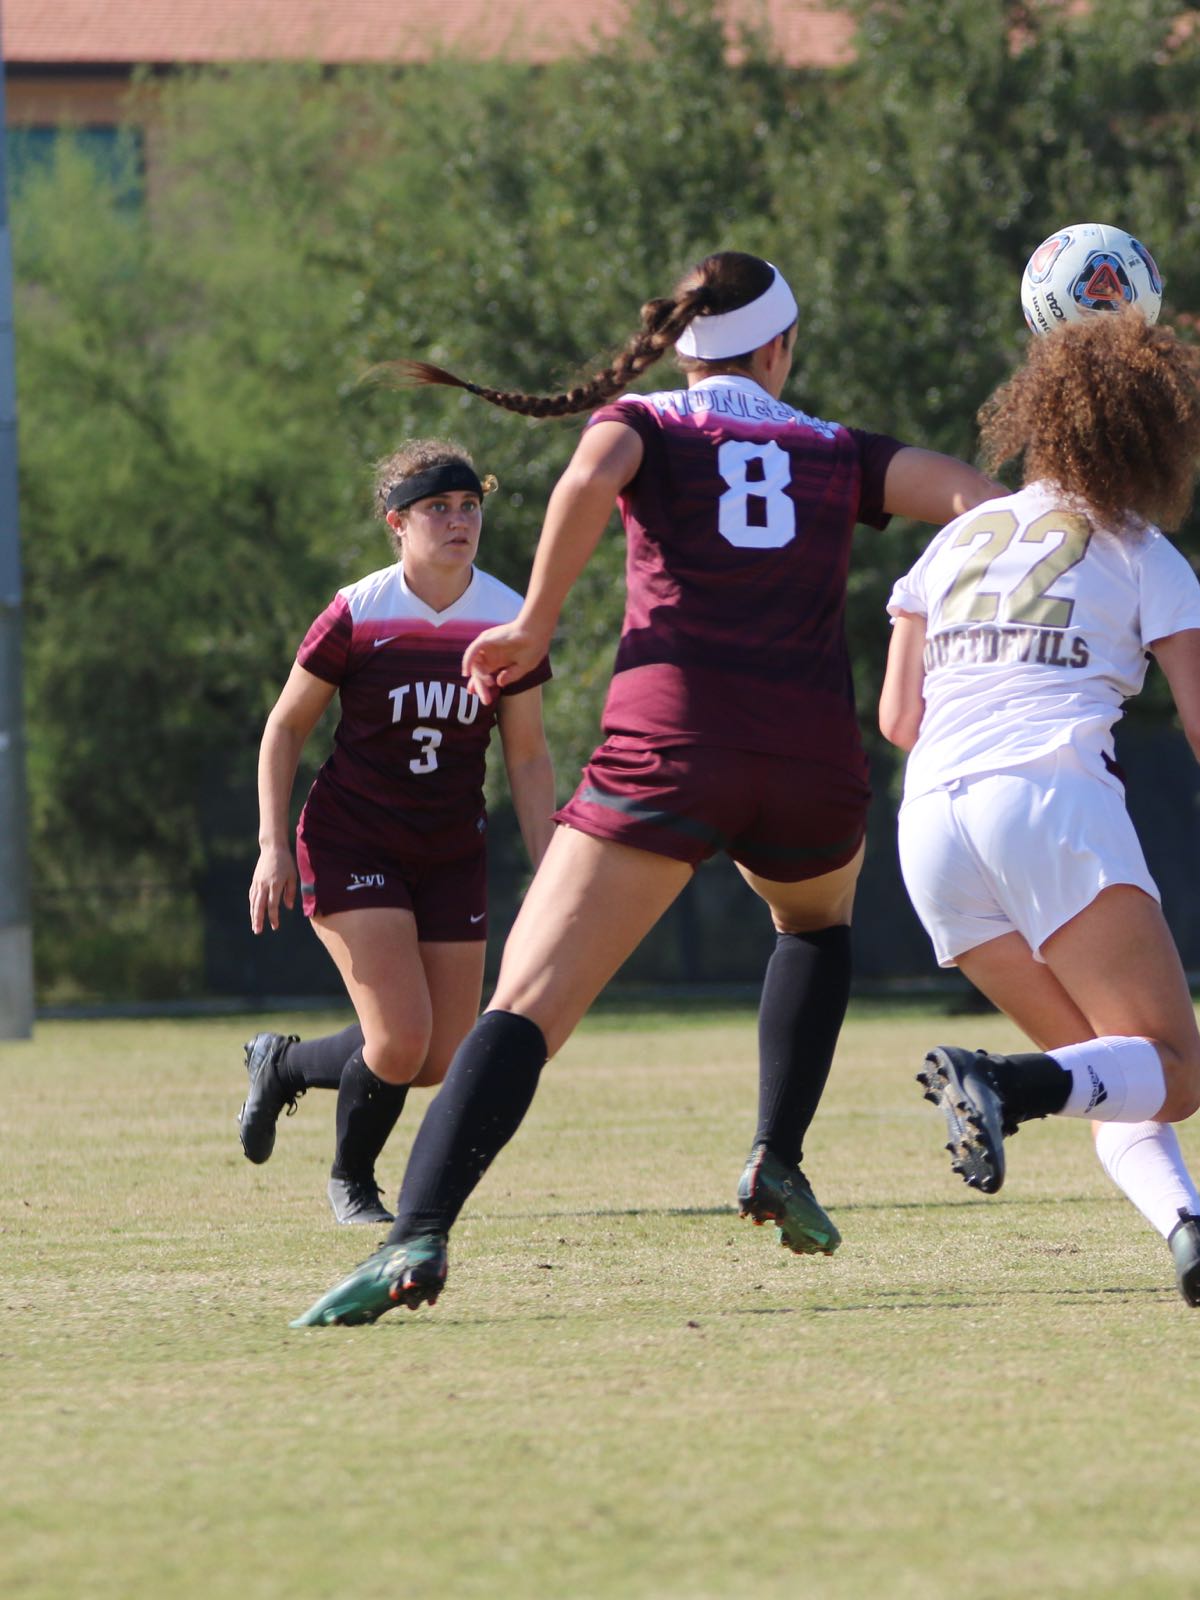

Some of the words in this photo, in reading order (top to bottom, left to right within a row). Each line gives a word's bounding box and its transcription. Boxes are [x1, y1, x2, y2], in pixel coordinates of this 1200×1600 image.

[718, 439, 797, 549] 8
[941, 509, 1095, 629] 22
[388, 681, 480, 726] TWU
[409, 726, 443, 775] 3
